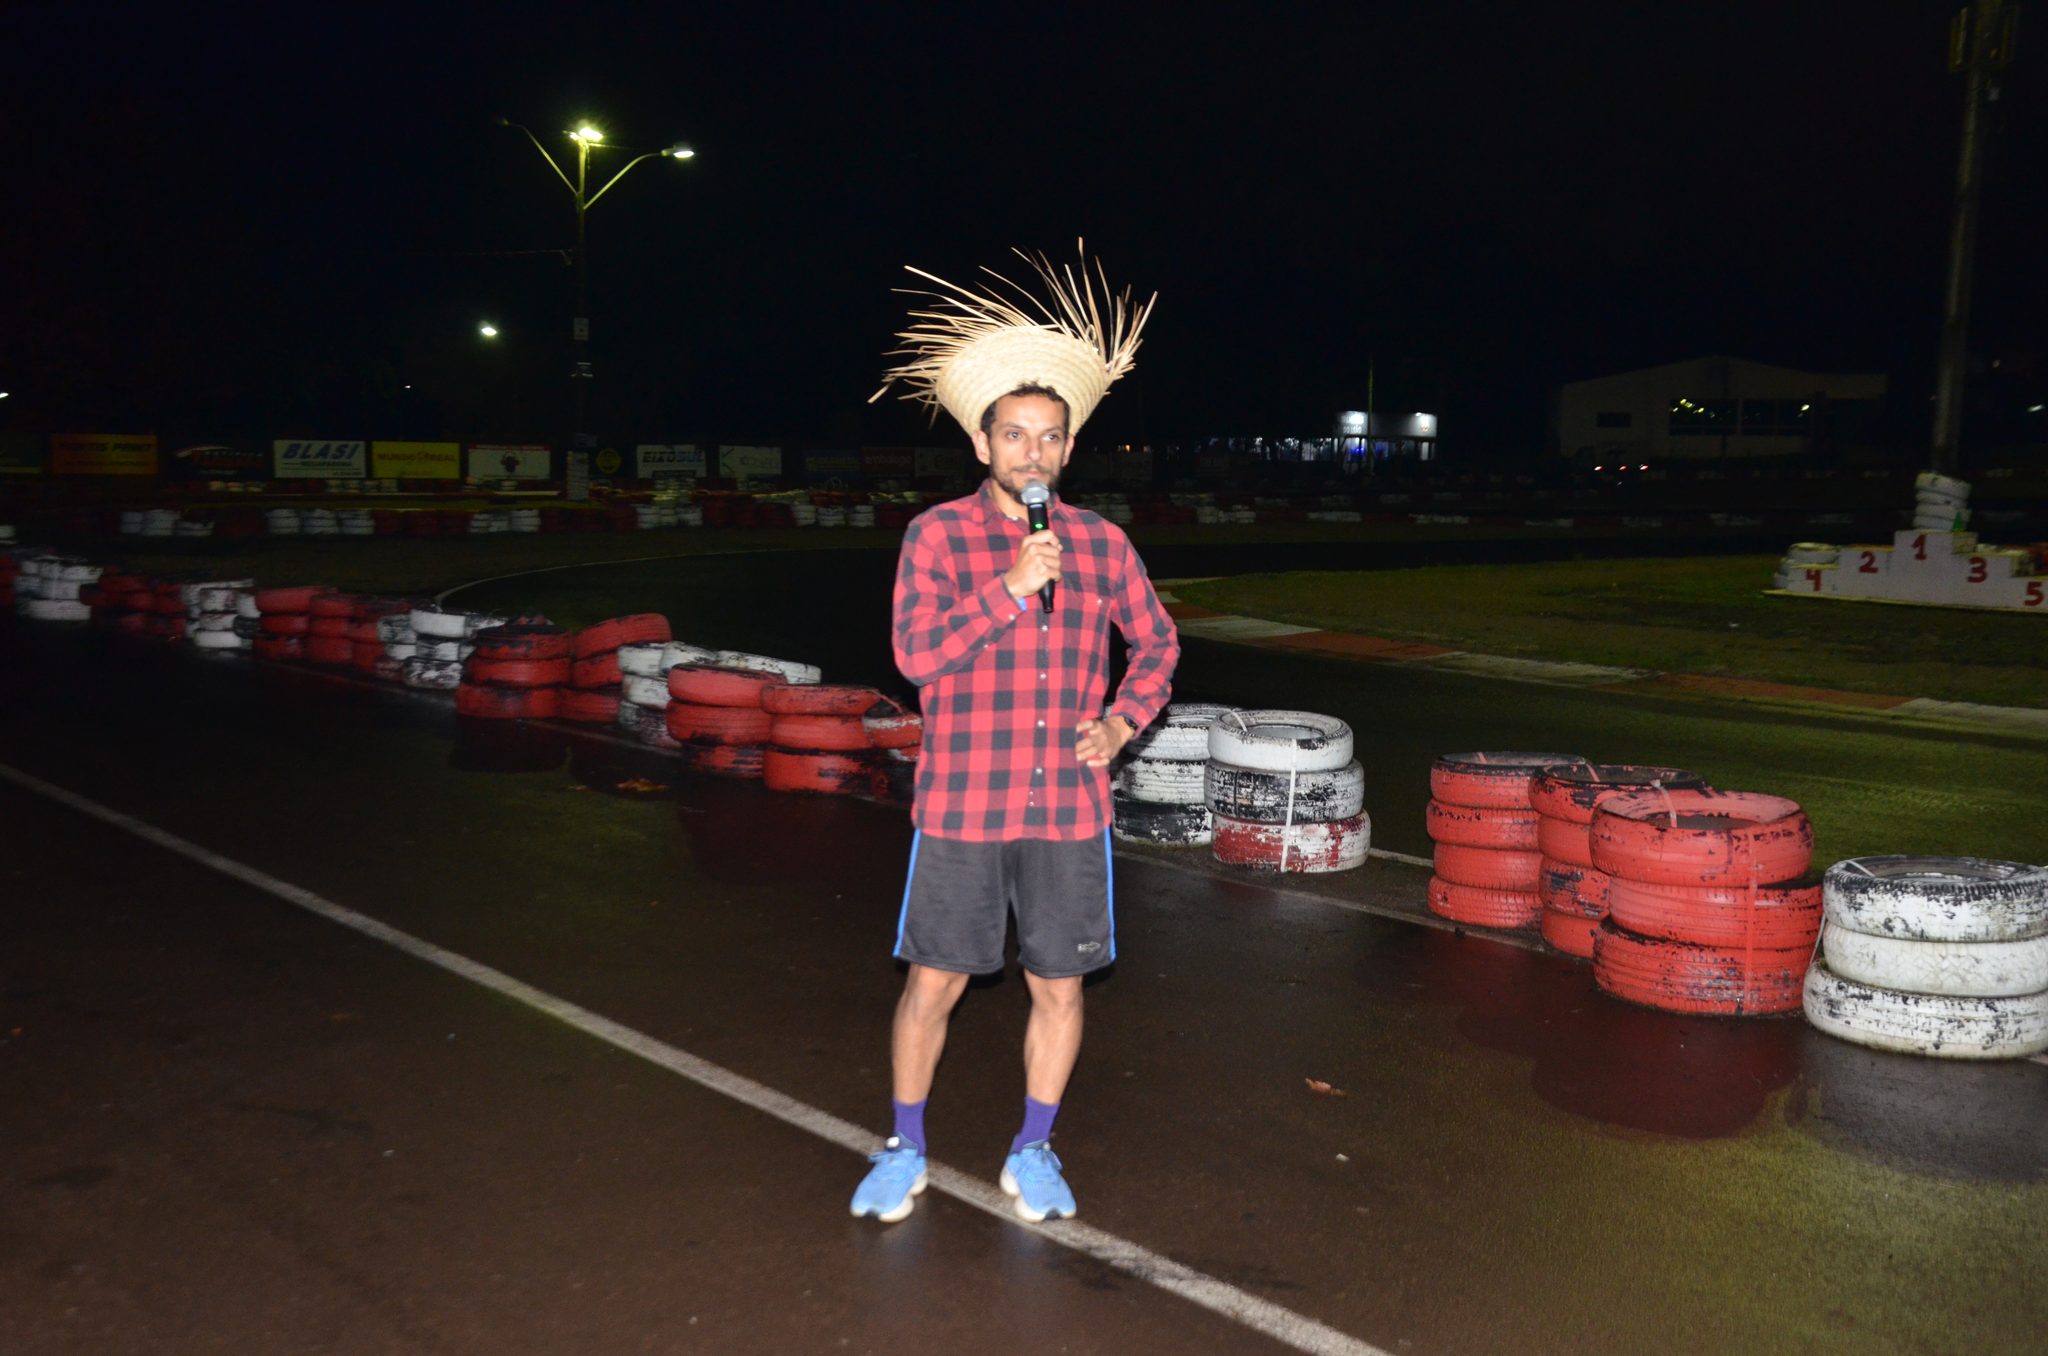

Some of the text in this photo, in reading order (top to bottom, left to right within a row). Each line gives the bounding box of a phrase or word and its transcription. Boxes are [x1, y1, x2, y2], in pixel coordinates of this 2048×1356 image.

[282, 443, 360, 459] BLASI
[1911, 534, 1927, 560] 1
[1859, 551, 1878, 573] 2
[1967, 556, 1987, 583] 3
[1806, 568, 1821, 592] 4
[2025, 581, 2043, 606] 5
